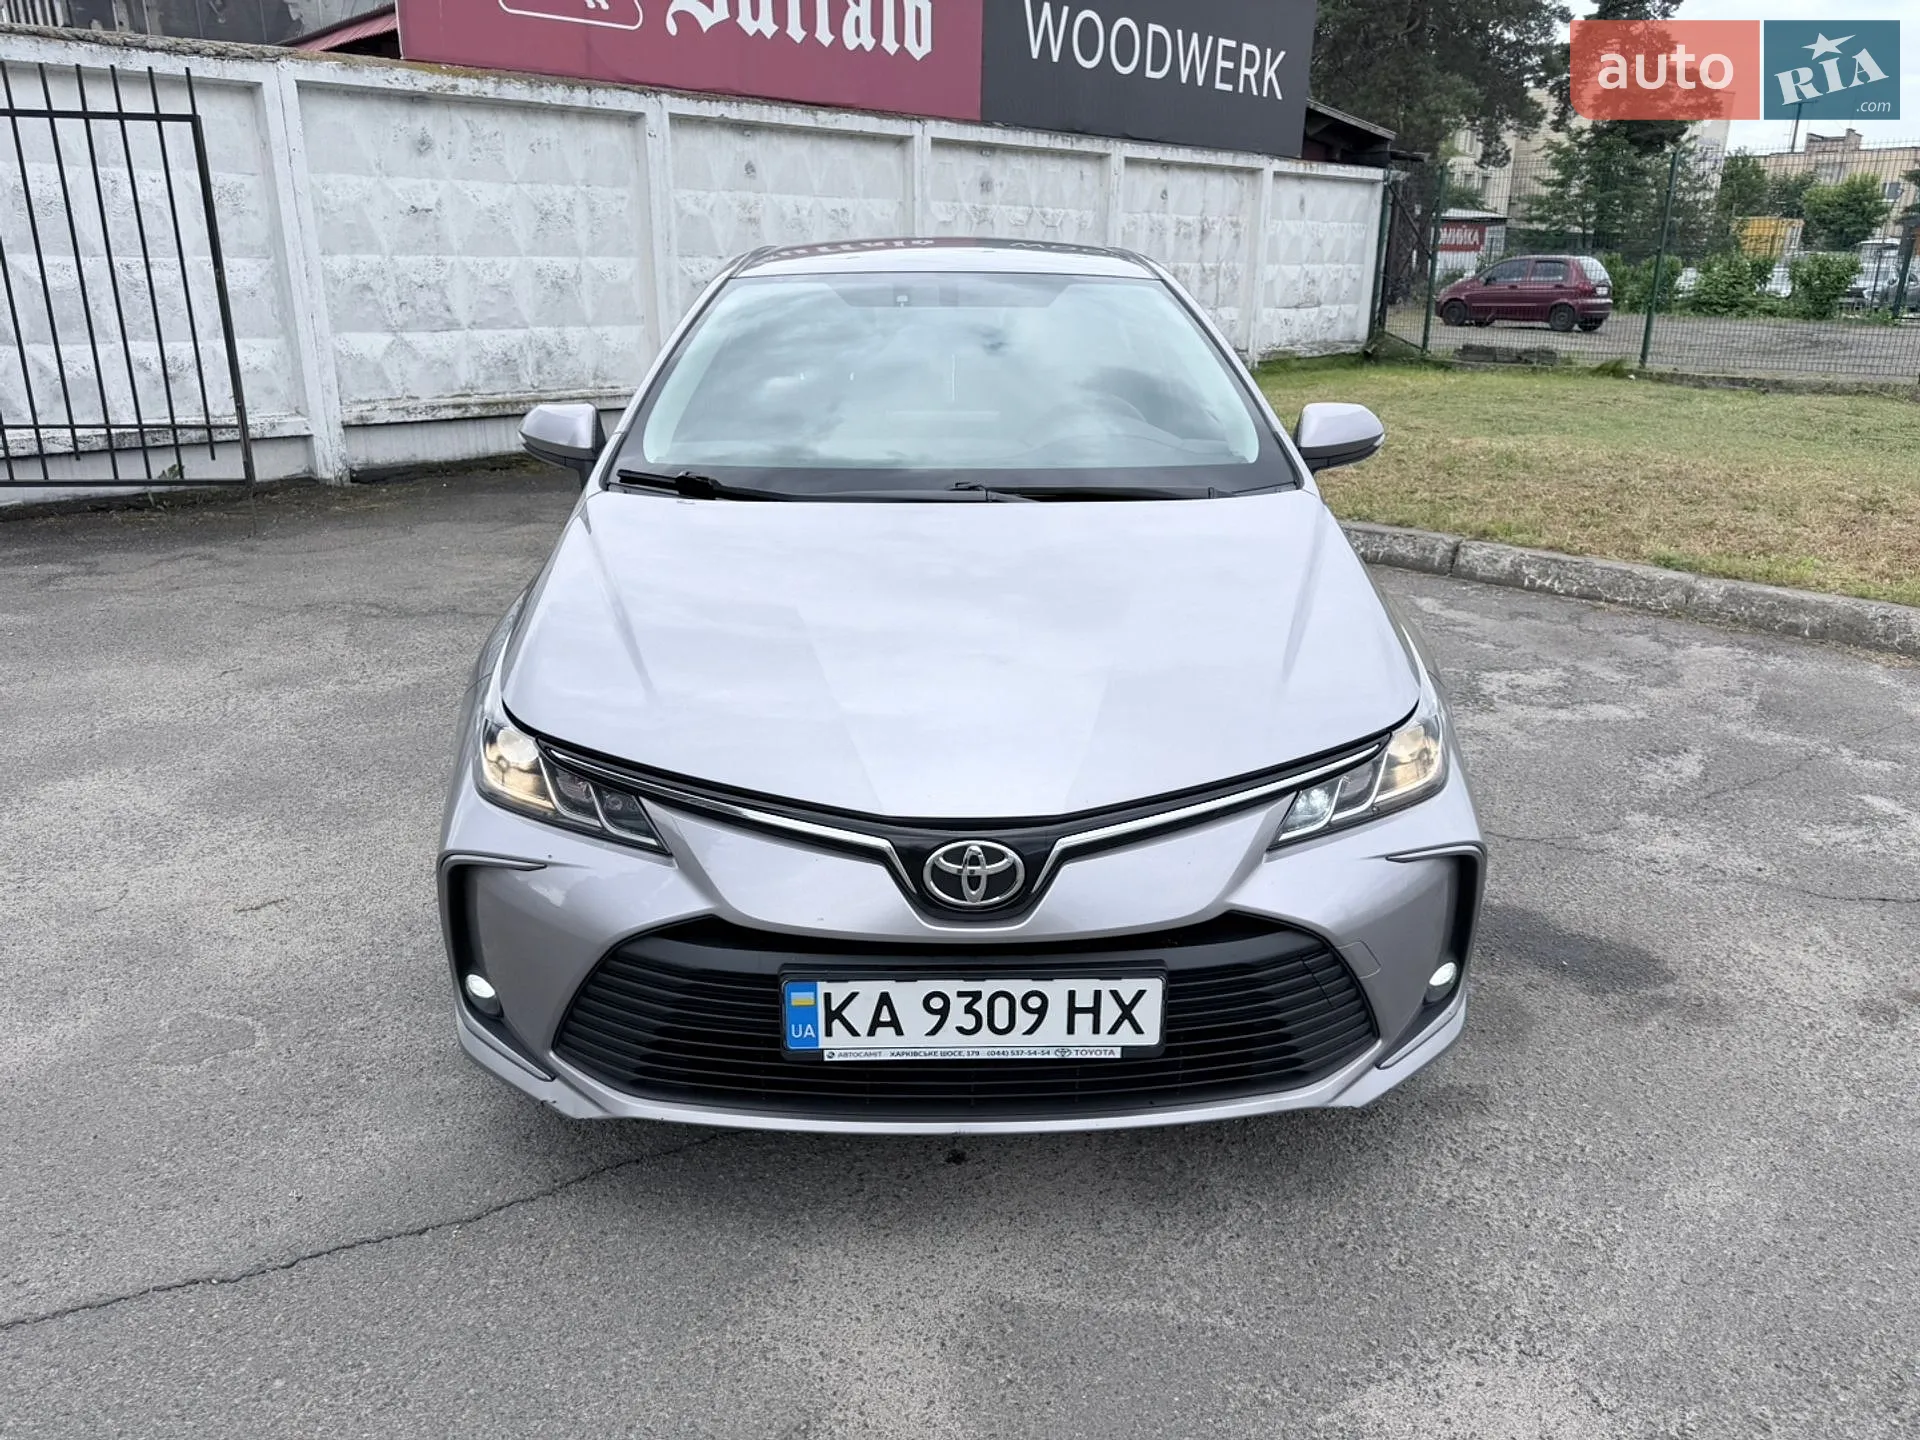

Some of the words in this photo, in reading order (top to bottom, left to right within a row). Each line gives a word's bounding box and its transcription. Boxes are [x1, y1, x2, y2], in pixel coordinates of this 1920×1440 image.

[1024, 0, 1286, 100] WOODWERK
[824, 991, 904, 1038] KA
[922, 990, 1050, 1036] 9309
[1066, 989, 1148, 1035] HX
[791, 1023, 816, 1039] UA
[1074, 1048, 1116, 1057] TOYOTA
